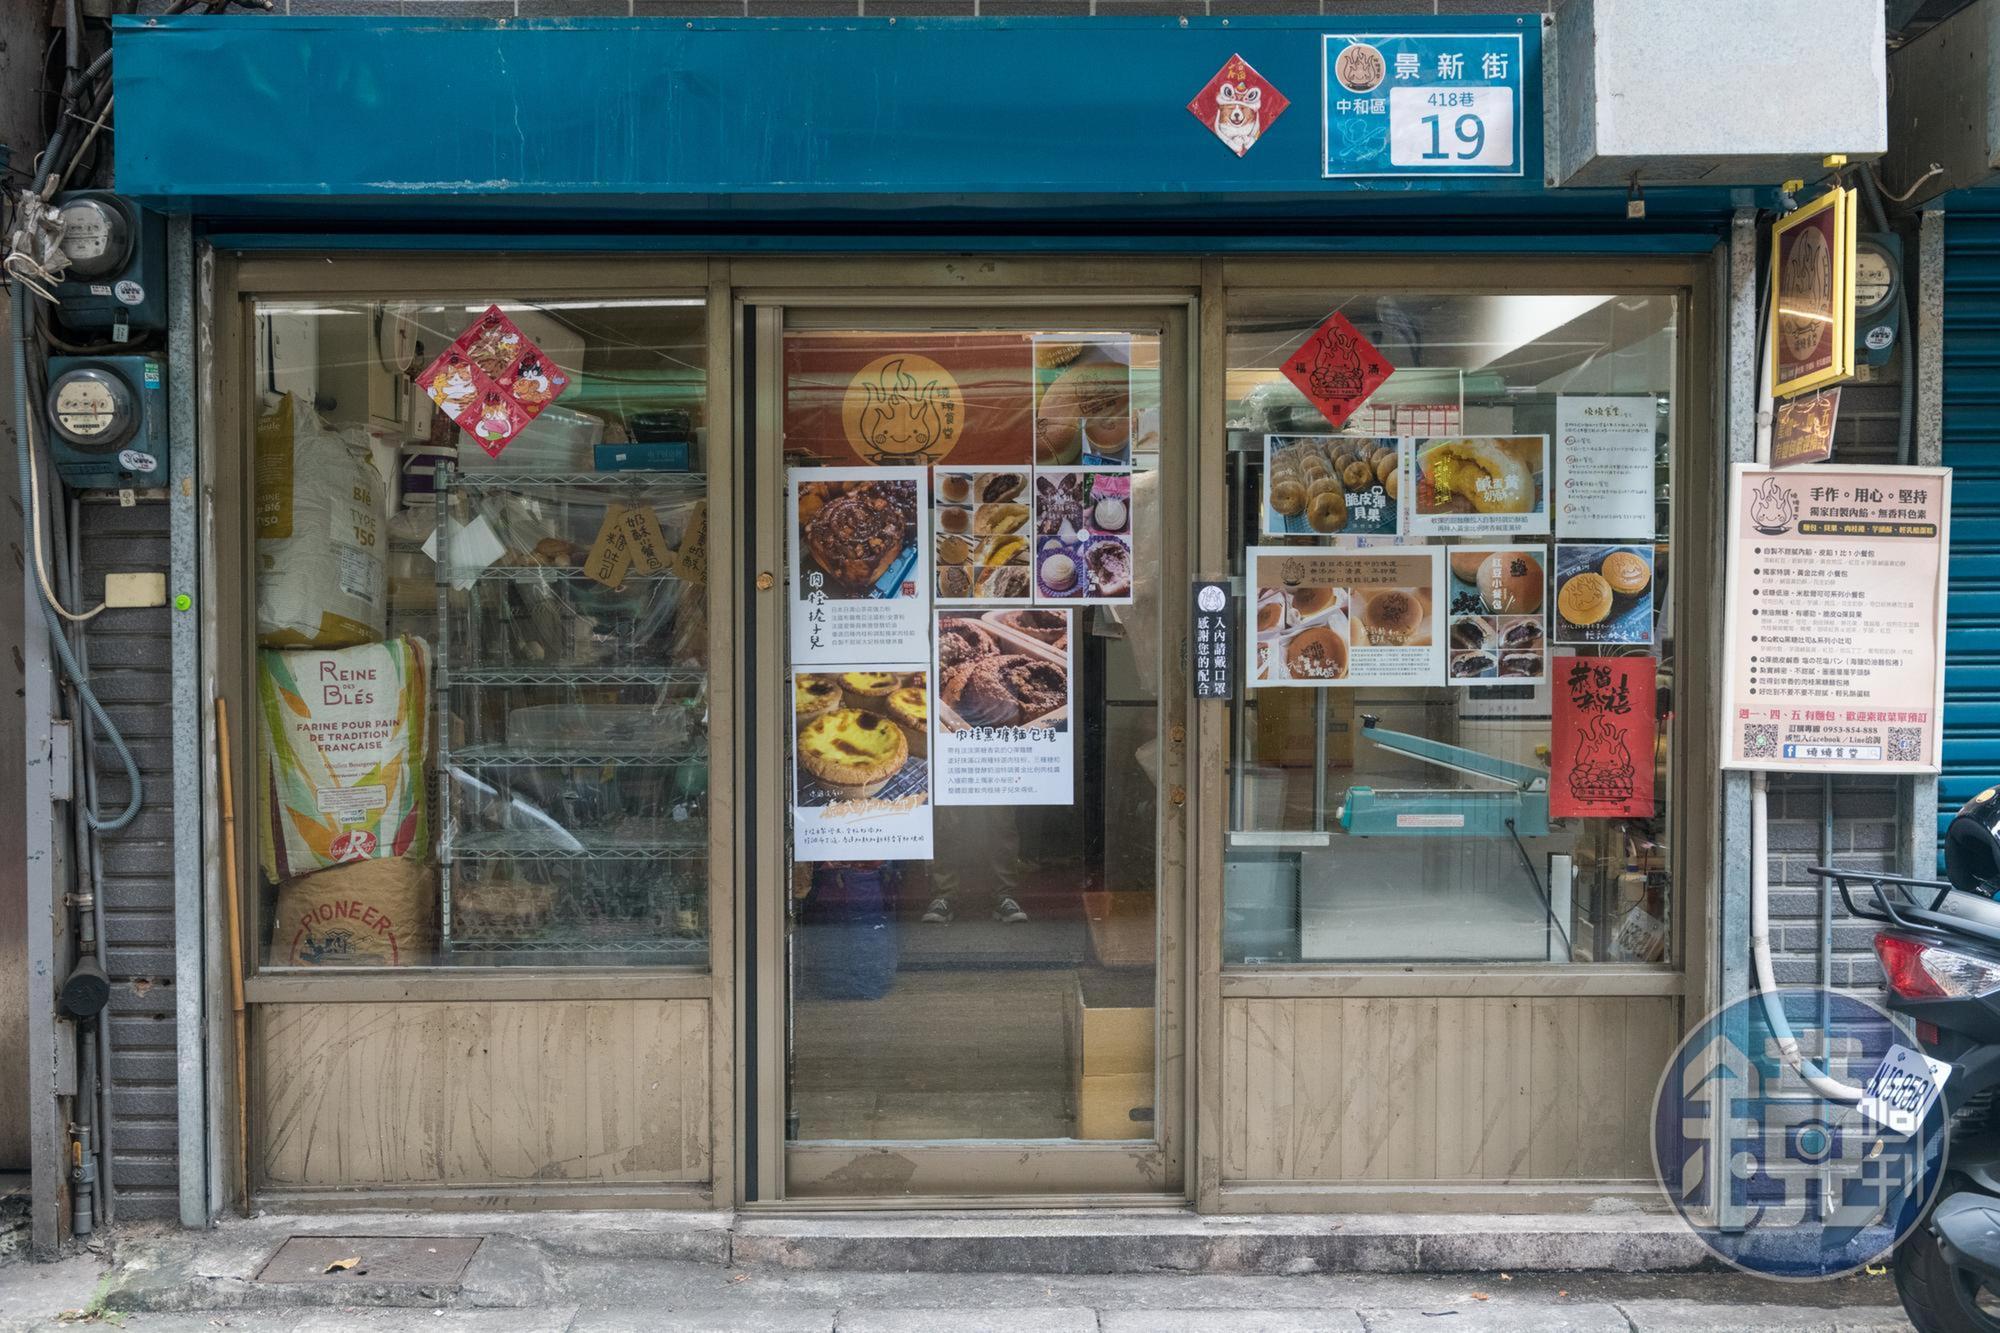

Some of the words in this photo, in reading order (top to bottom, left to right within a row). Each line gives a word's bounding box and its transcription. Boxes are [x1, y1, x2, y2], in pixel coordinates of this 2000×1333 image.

[1394, 53, 1508, 80] 景新街
[1336, 98, 1387, 116] 中和區
[1428, 91, 1474, 107] 418巷
[1421, 113, 1486, 160] 19
[353, 486, 372, 506] Blé
[351, 508, 377, 533] TYPE
[1354, 506, 1381, 522] 貝果
[353, 526, 376, 547] 150
[1197, 616, 1210, 695] 感謝您的配合
[1214, 616, 1227, 696] 入內請戴口罩
[1567, 661, 1612, 693] 恭賀
[296, 722, 339, 732] FARINE
[341, 721, 373, 730] POUR
[375, 719, 401, 729] PAIN
[1823, 726, 1878, 734] 0953-854-888
[309, 733, 326, 742] DE
[327, 731, 389, 741] TRADITION
[317, 741, 383, 753] FRANÇAISE
[302, 900, 393, 936] PIONEER
